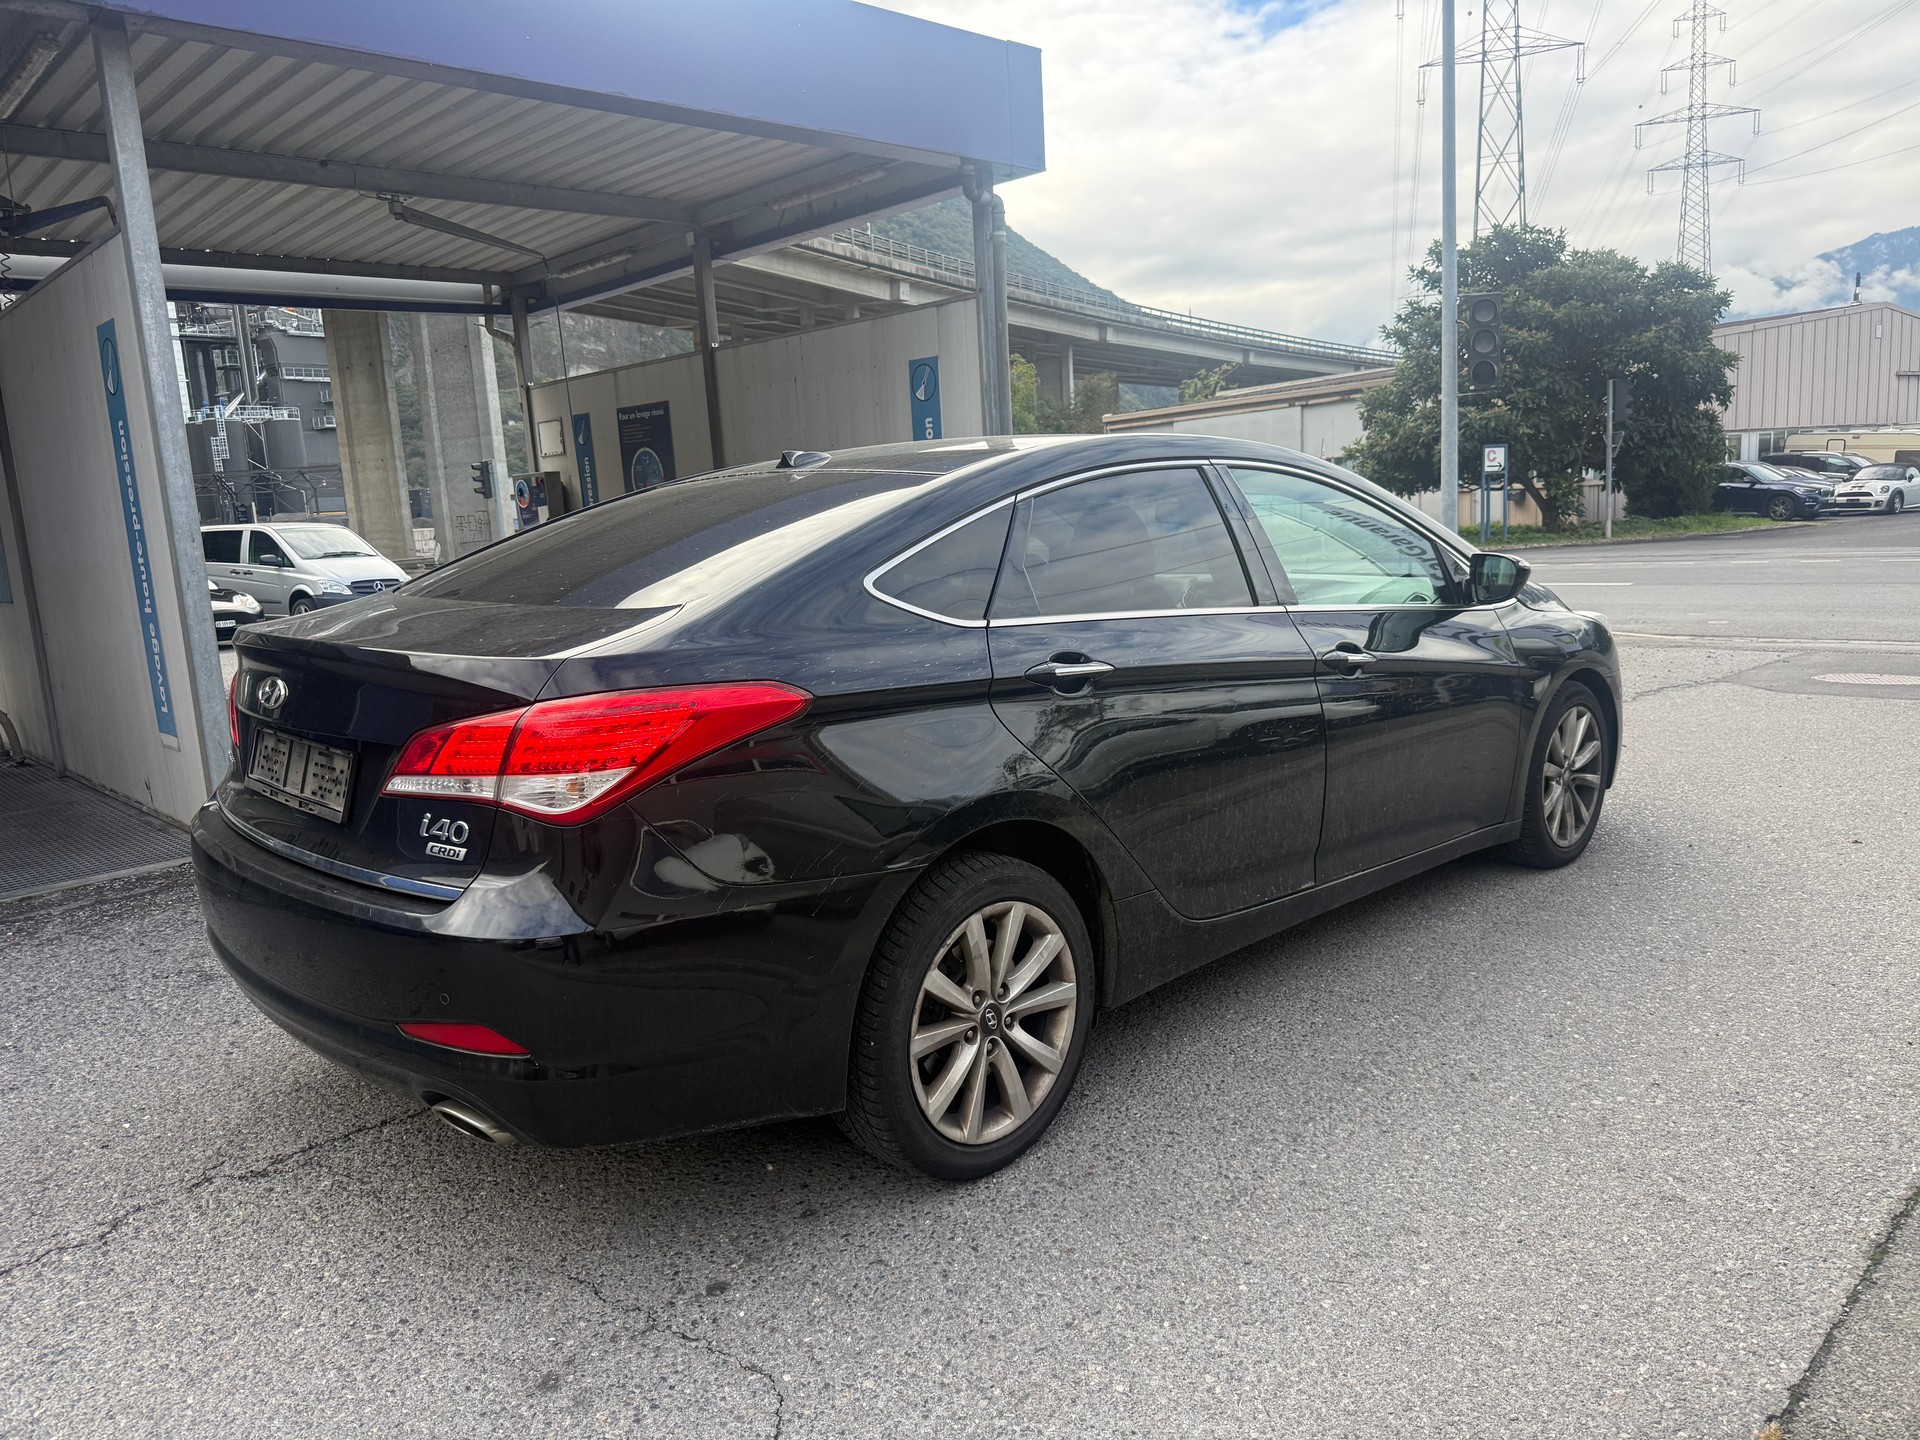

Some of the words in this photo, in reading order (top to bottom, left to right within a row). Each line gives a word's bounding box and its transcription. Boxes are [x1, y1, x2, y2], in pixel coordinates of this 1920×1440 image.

[629, 412, 636, 420] un
[636, 410, 651, 420] lavage
[1486, 449, 1497, 463] C
[584, 457, 594, 505] ression
[118, 419, 152, 614] haute-pression
[149, 622, 169, 713] Lavage
[419, 813, 469, 844] i40
[430, 844, 462, 859] CRDi
